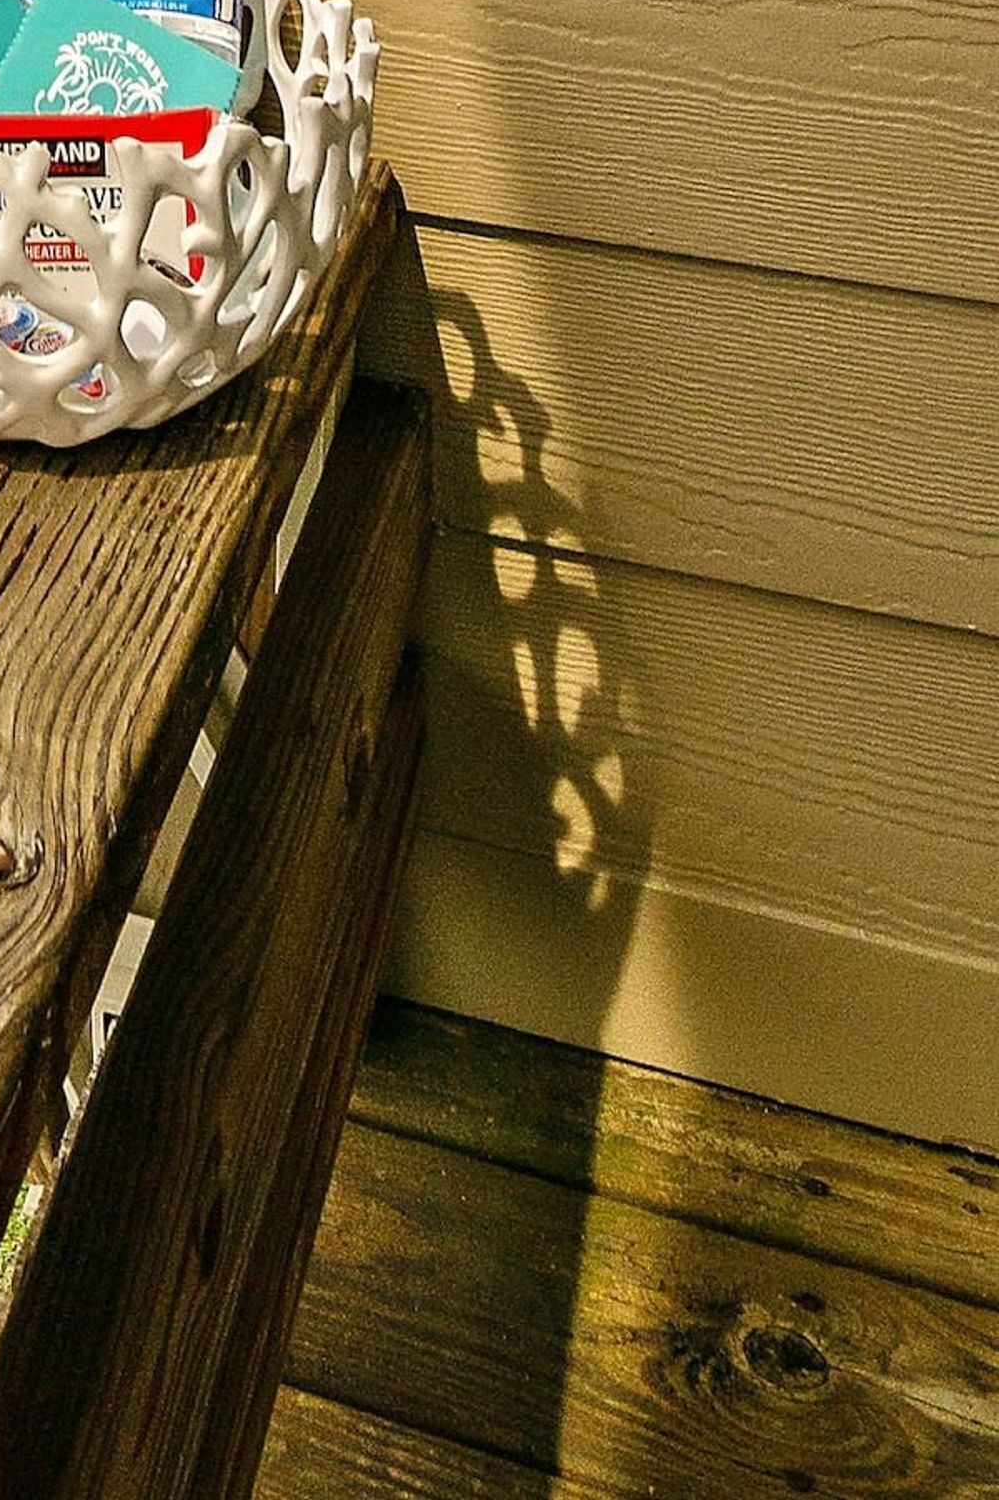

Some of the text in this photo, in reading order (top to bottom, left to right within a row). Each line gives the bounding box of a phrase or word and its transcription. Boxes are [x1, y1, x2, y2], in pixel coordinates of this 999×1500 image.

[73, 30, 168, 91] DON'T WORRY
[25, 245, 72, 260] HEATER
